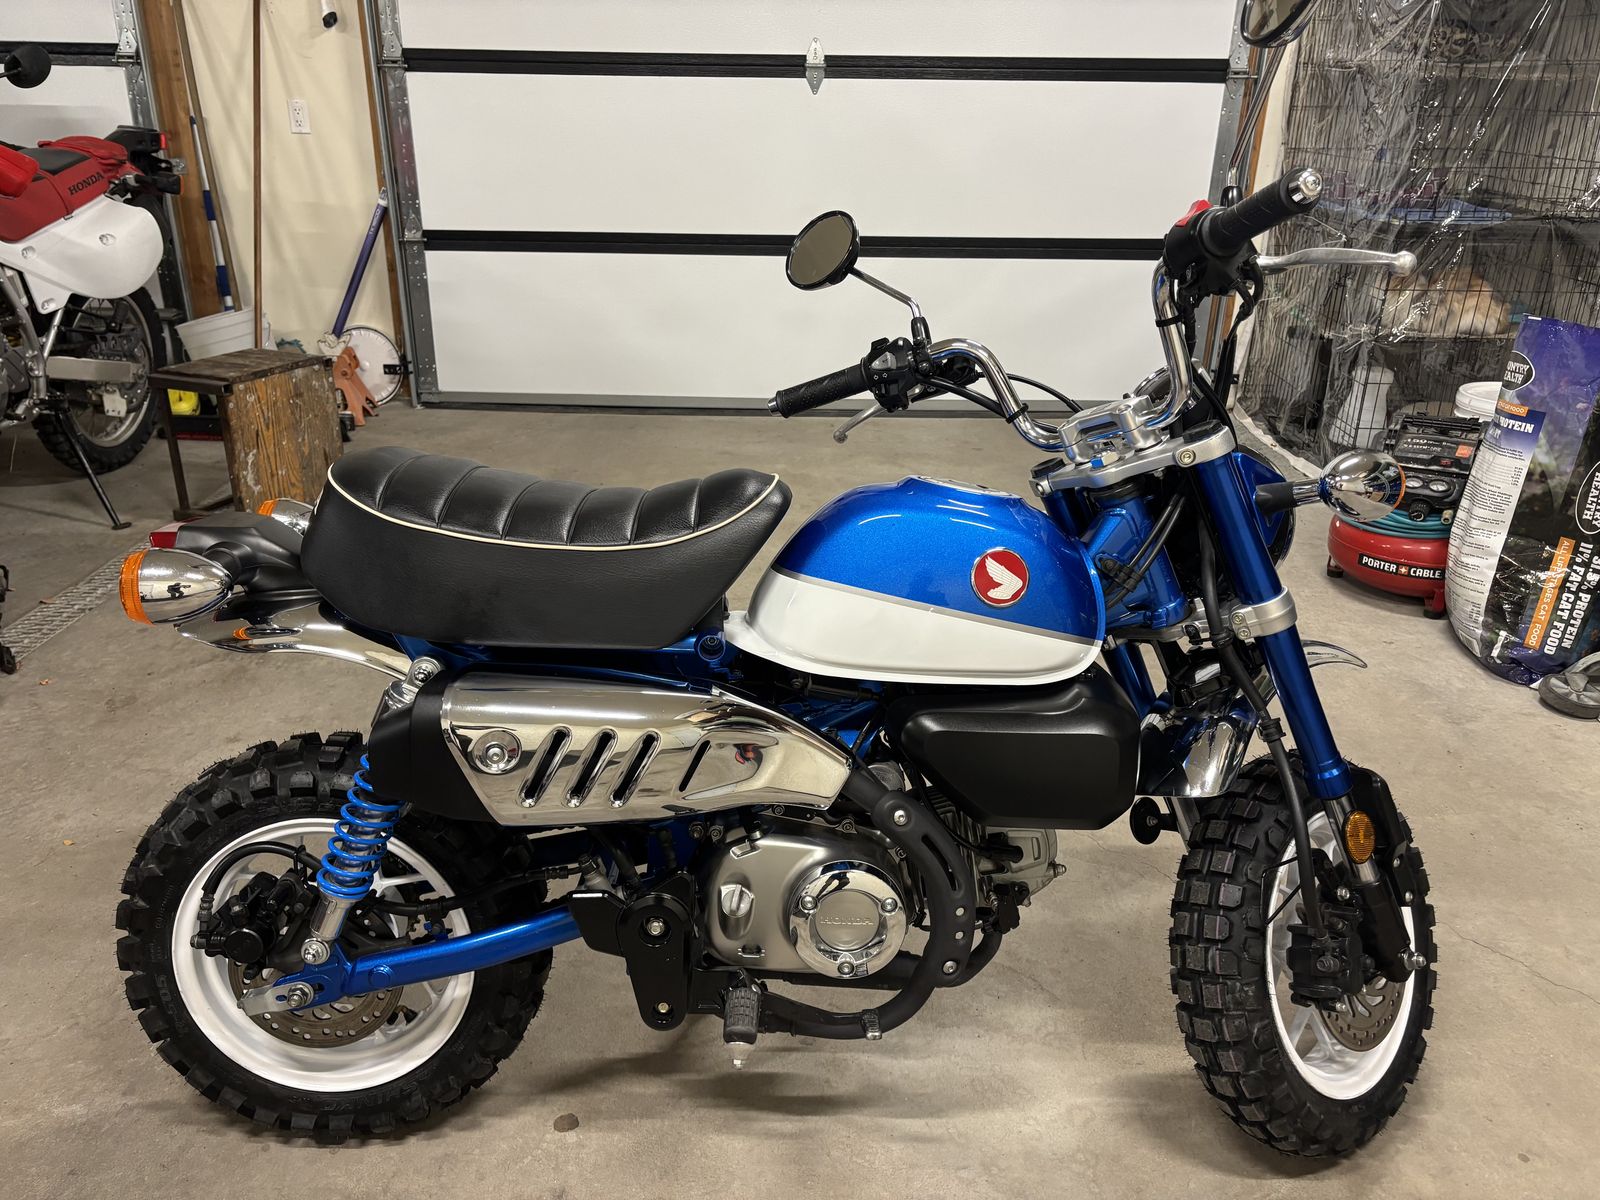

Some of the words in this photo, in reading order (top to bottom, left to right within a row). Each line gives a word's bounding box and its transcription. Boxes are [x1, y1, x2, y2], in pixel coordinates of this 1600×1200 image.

[68, 172, 105, 195] HONDA
[1362, 556, 1397, 573] PORTER
[1410, 568, 1442, 578] CABLE
[1566, 565, 1585, 591] FAT
[1538, 605, 1549, 620] CAT
[1557, 593, 1575, 619] CAT
[1561, 592, 1591, 649] PROTEIN
[1529, 623, 1542, 646] FOOD
[1543, 621, 1565, 655] FOOD
[820, 916, 874, 926] HONDA
